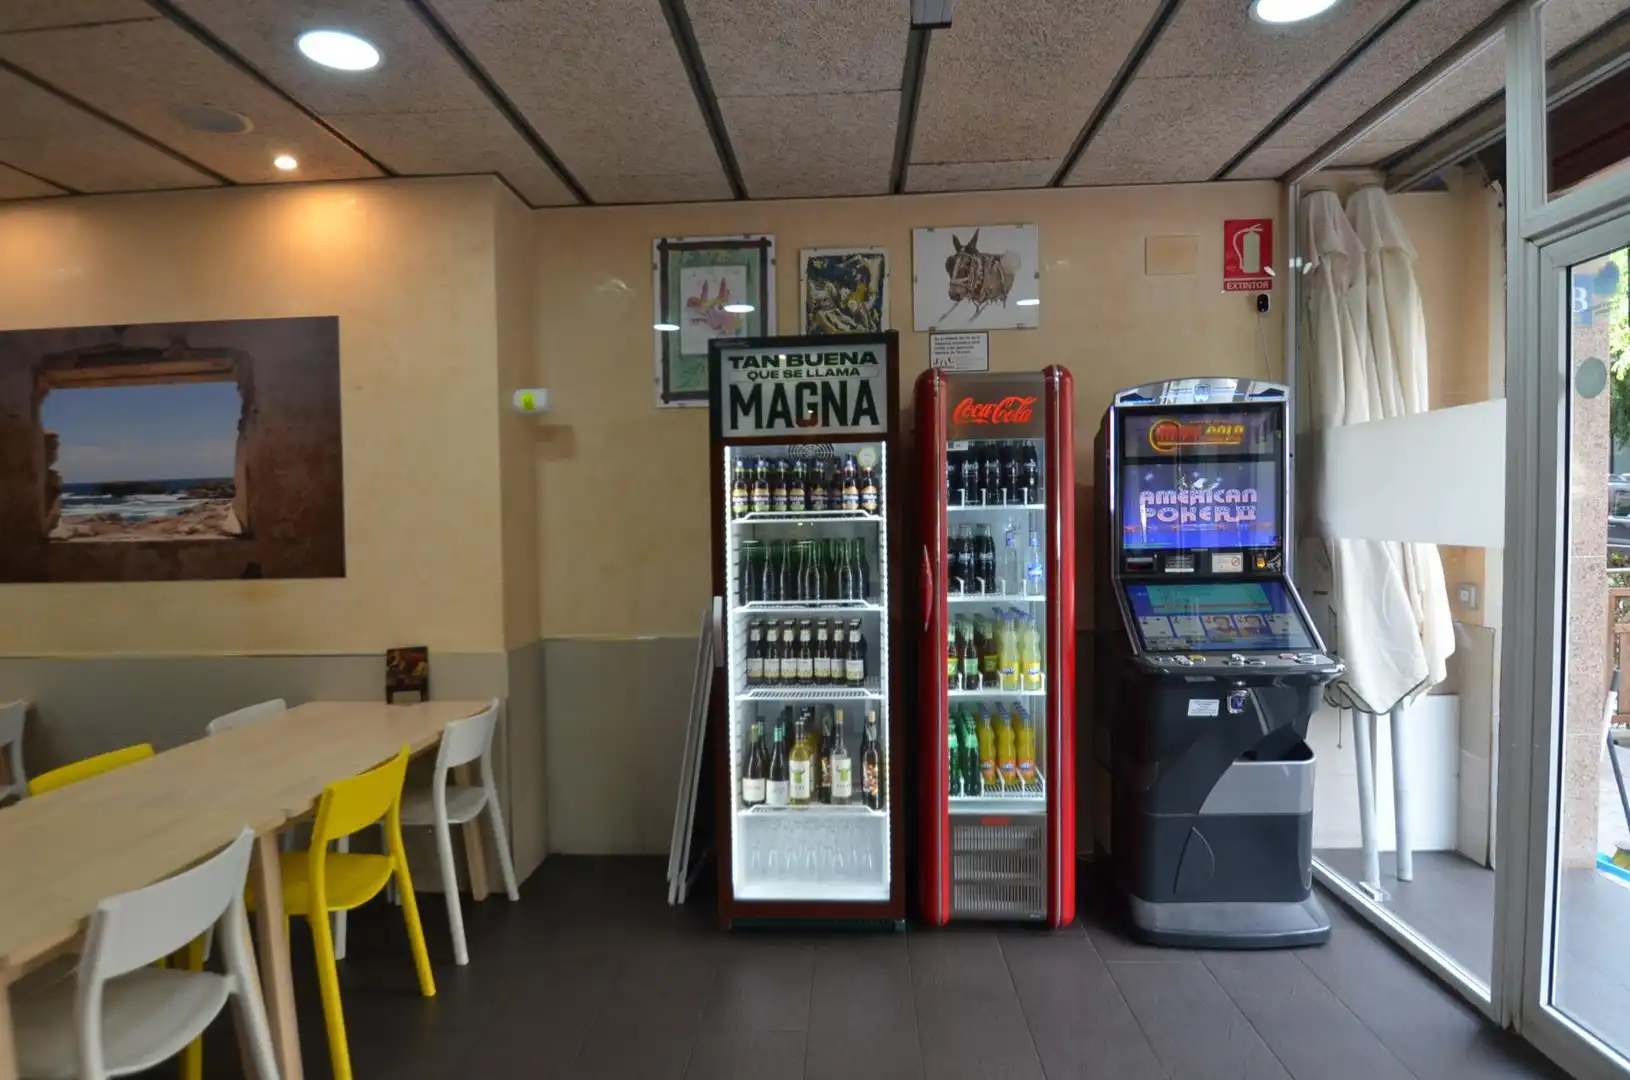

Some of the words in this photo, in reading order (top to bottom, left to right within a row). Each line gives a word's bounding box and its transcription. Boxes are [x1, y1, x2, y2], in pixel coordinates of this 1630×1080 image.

[1226, 281, 1269, 290] EXTINTOR
[728, 354, 779, 369] TAN
[786, 351, 879, 367] BUENA
[747, 369, 779, 381] QUE
[783, 369, 803, 379] SE
[806, 367, 861, 378] LLAMA
[729, 379, 880, 430] MAGNA
[1139, 488, 1257, 506] AMERICAN
[1140, 505, 1230, 524] POKER
